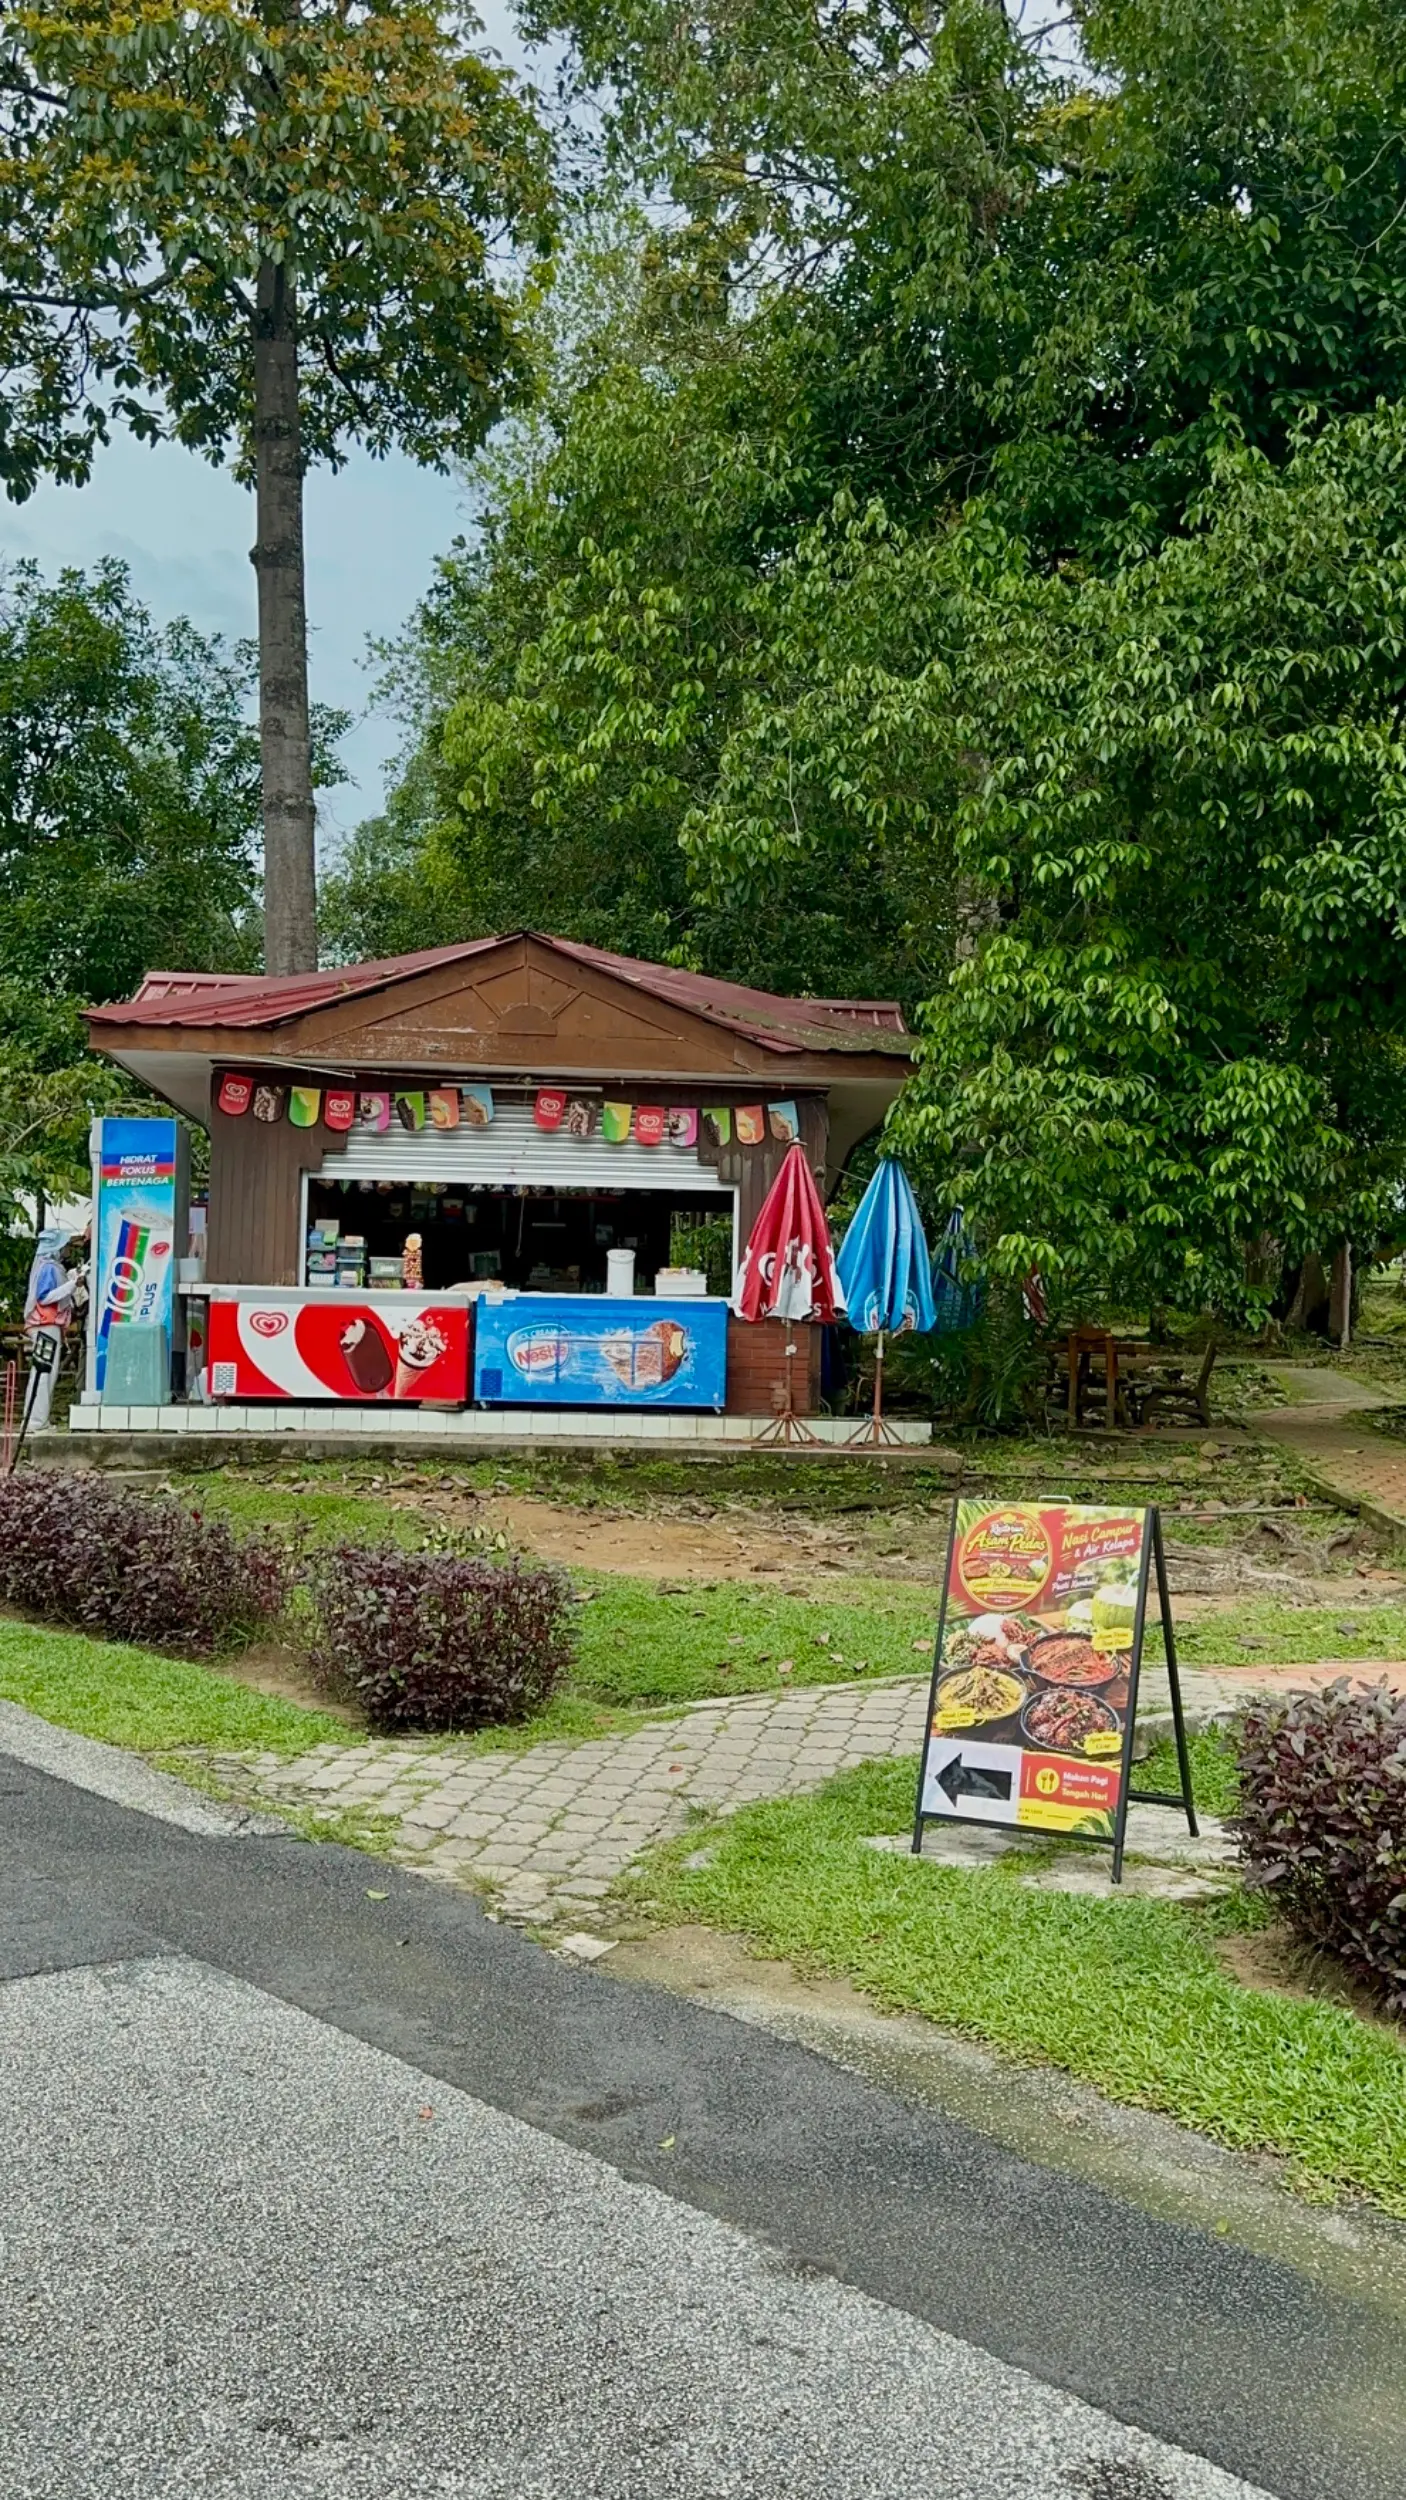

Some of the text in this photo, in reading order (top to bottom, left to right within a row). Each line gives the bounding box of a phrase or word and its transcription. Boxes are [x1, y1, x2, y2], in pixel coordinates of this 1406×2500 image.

[120, 1154, 158, 1165] HIDRAT
[120, 1165, 157, 1176] FOKUS
[106, 1176, 169, 1187] BERTENAGA
[140, 1282, 157, 1316] PLUS
[967, 1529, 1047, 1553] Asam Pedas
[1061, 1523, 1137, 1552] Nasi Campur
[1073, 1537, 1136, 1559] & Air Kelapa
[1063, 1771, 1109, 1787] Makan Pagi
[1062, 1787, 1108, 1801] Tengah Hari
